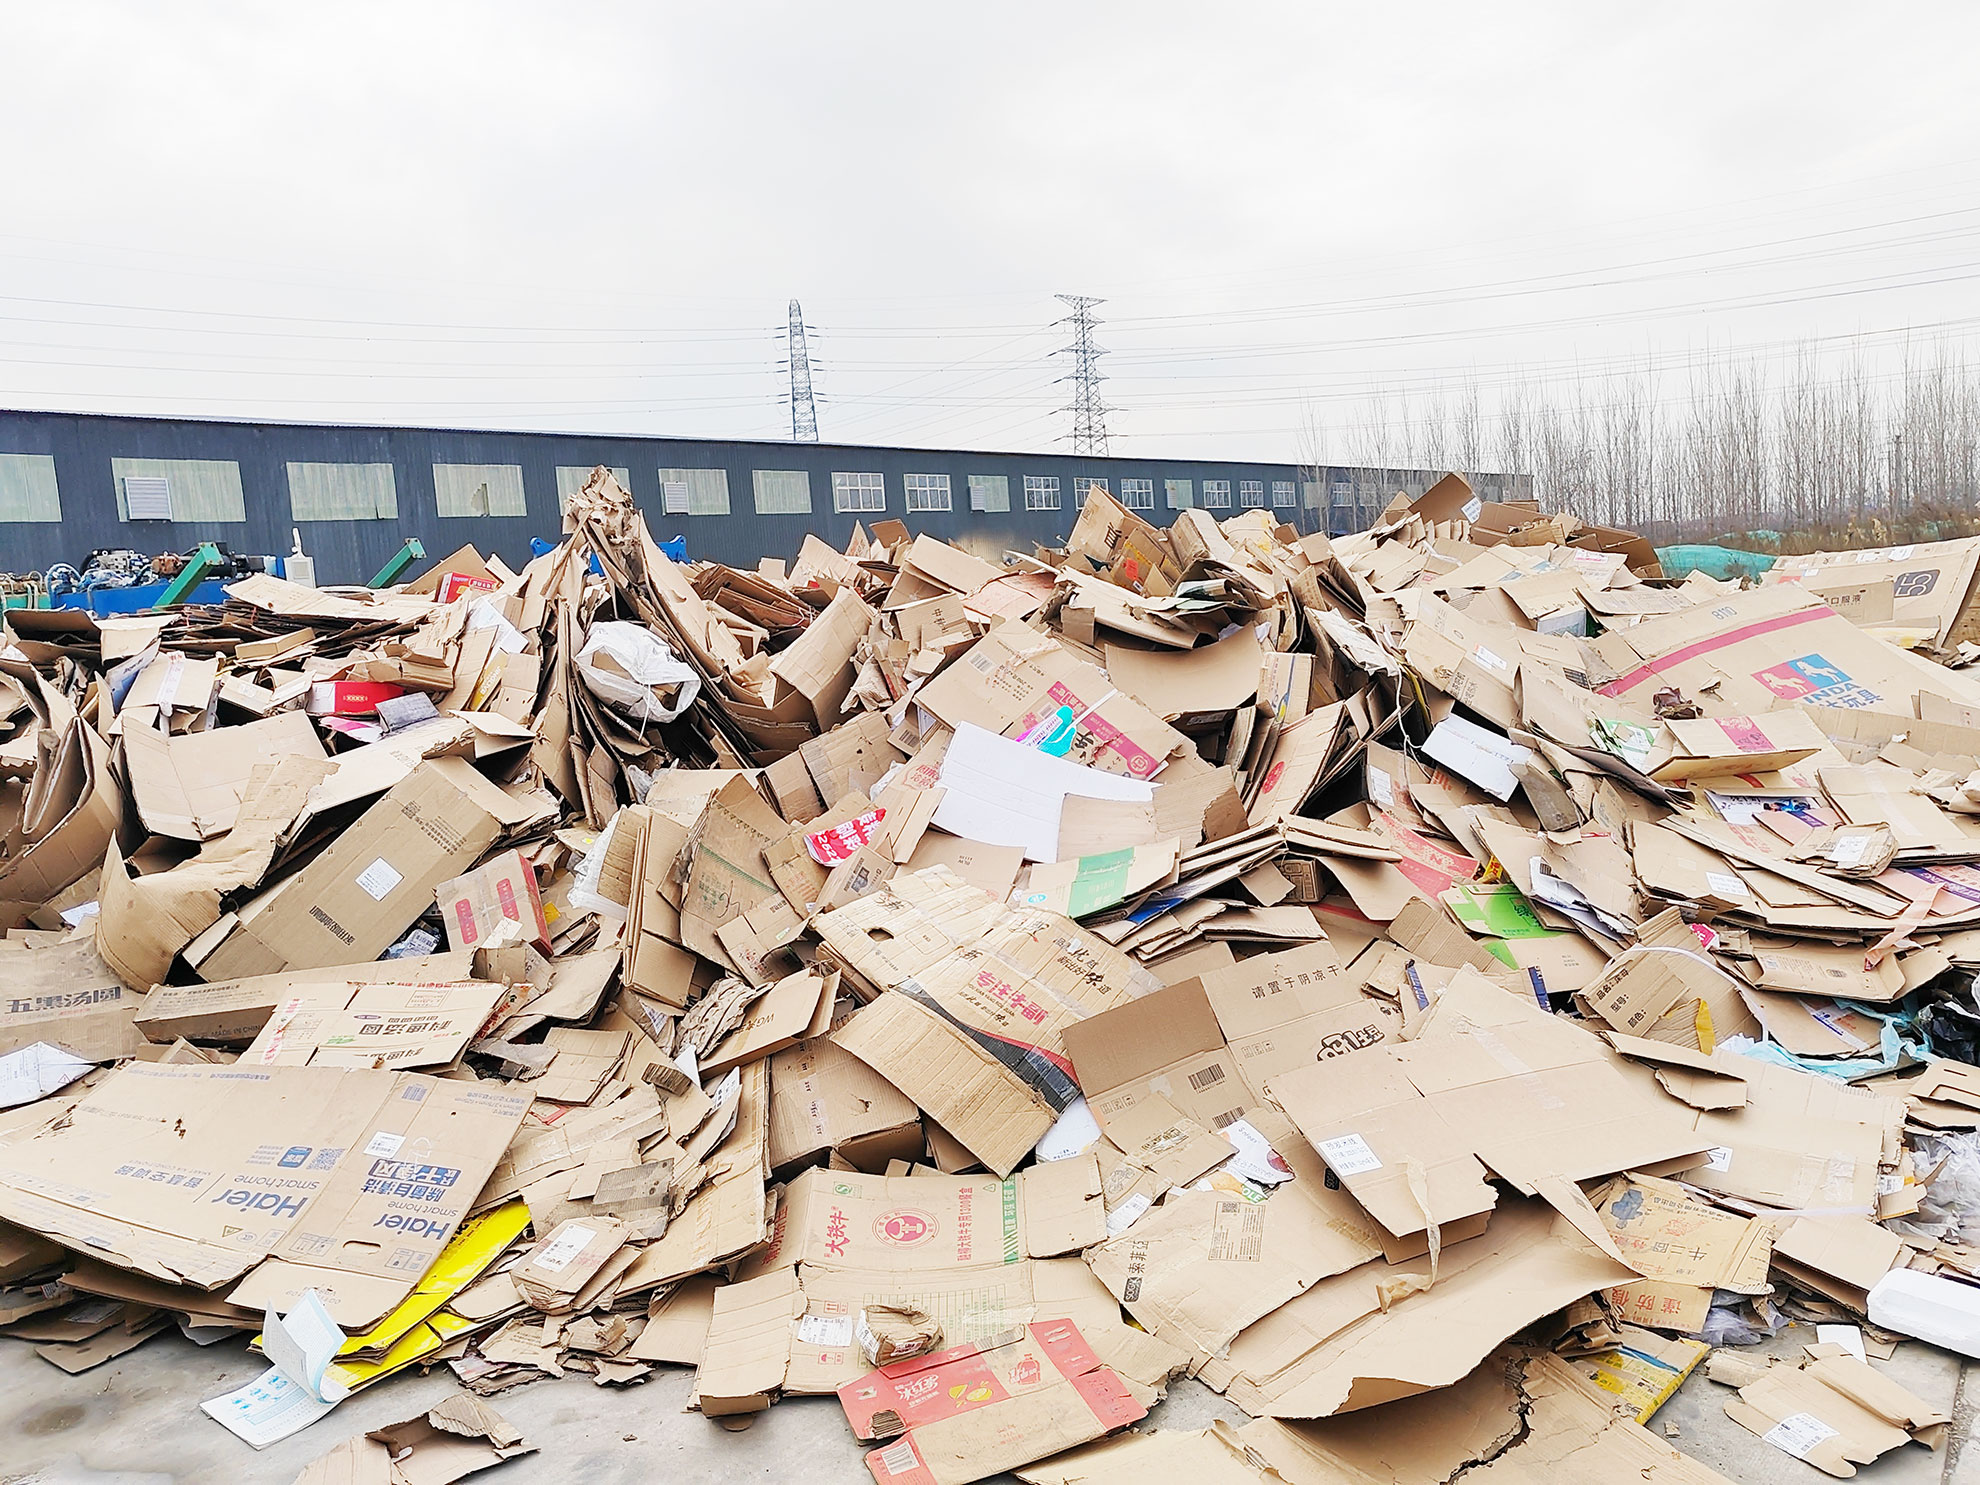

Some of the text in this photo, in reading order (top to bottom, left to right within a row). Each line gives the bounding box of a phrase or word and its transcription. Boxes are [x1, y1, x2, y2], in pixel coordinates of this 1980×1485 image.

[1824, 594, 1861, 606] 口服液
[1251, 964, 1342, 999] 请置于阴凉干
[359, 1020, 453, 1036] 科迪汤圆
[212, 1188, 309, 1219] Haier
[361, 1178, 448, 1203] 除菌自清洁
[373, 1212, 450, 1241] Haier
[824, 1210, 850, 1257] 大铁牛
